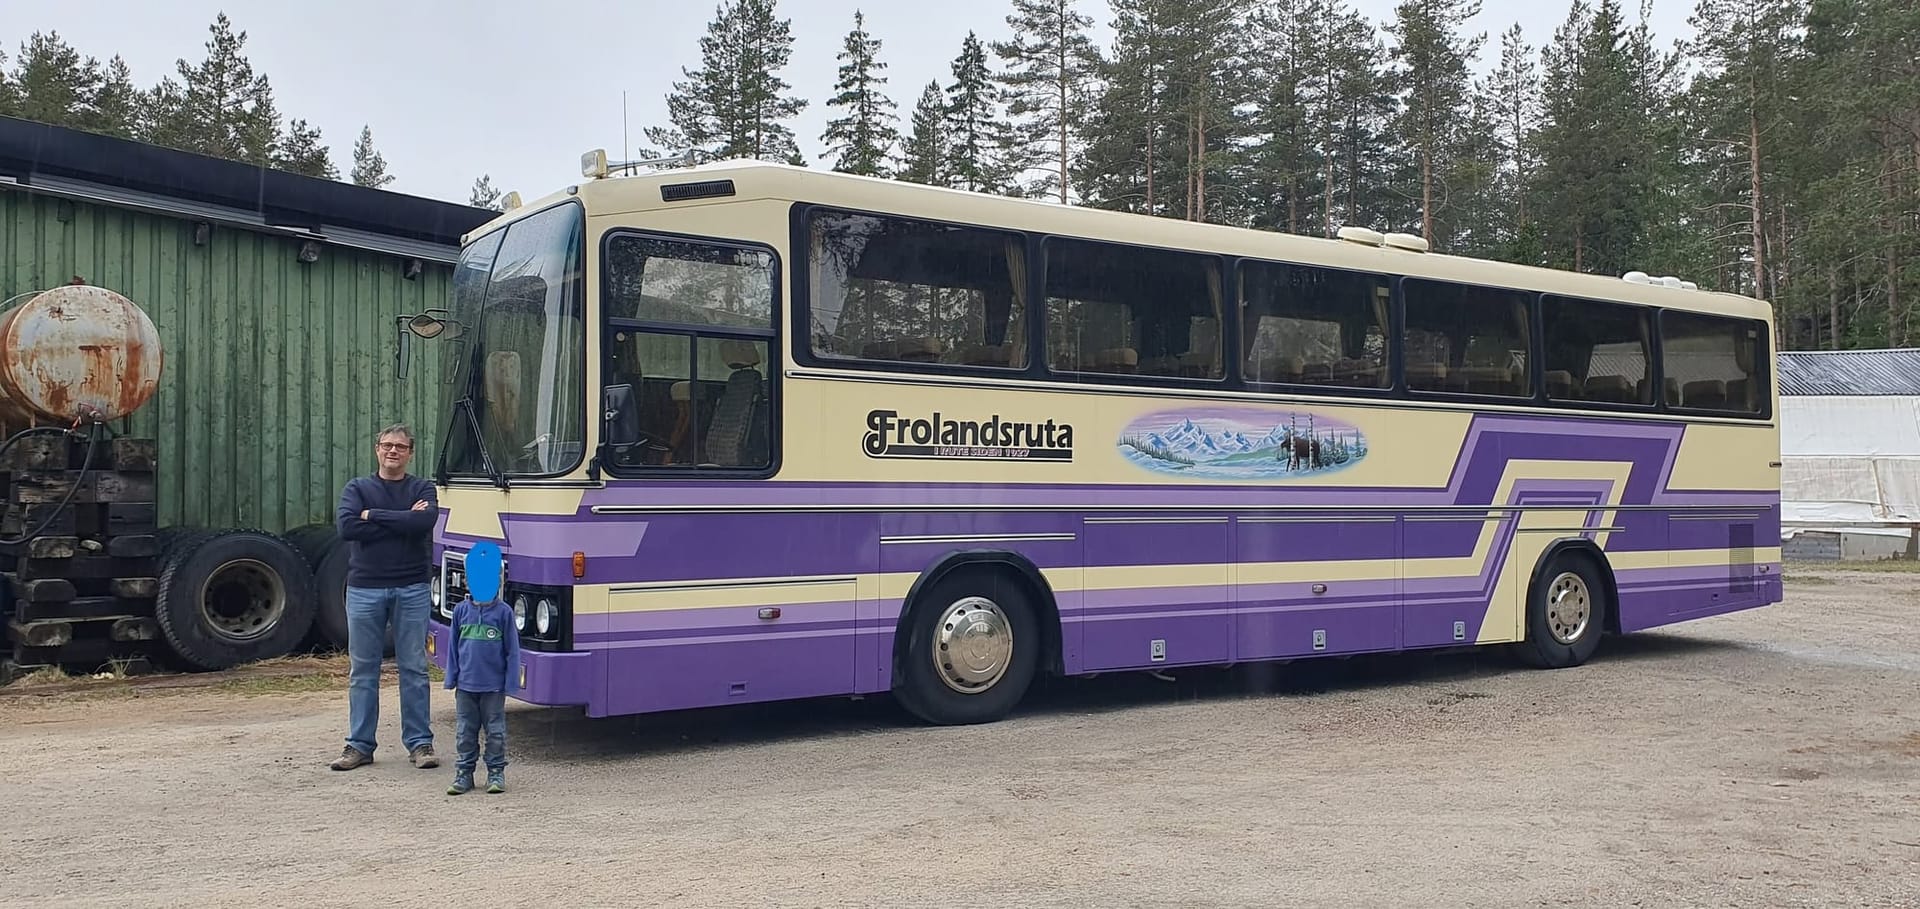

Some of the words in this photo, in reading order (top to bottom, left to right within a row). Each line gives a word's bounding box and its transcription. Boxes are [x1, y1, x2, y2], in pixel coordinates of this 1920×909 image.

[865, 409, 1073, 454] Frolandsruta
[940, 446, 969, 456] RUTE
[970, 447, 1002, 457] SIDEN
